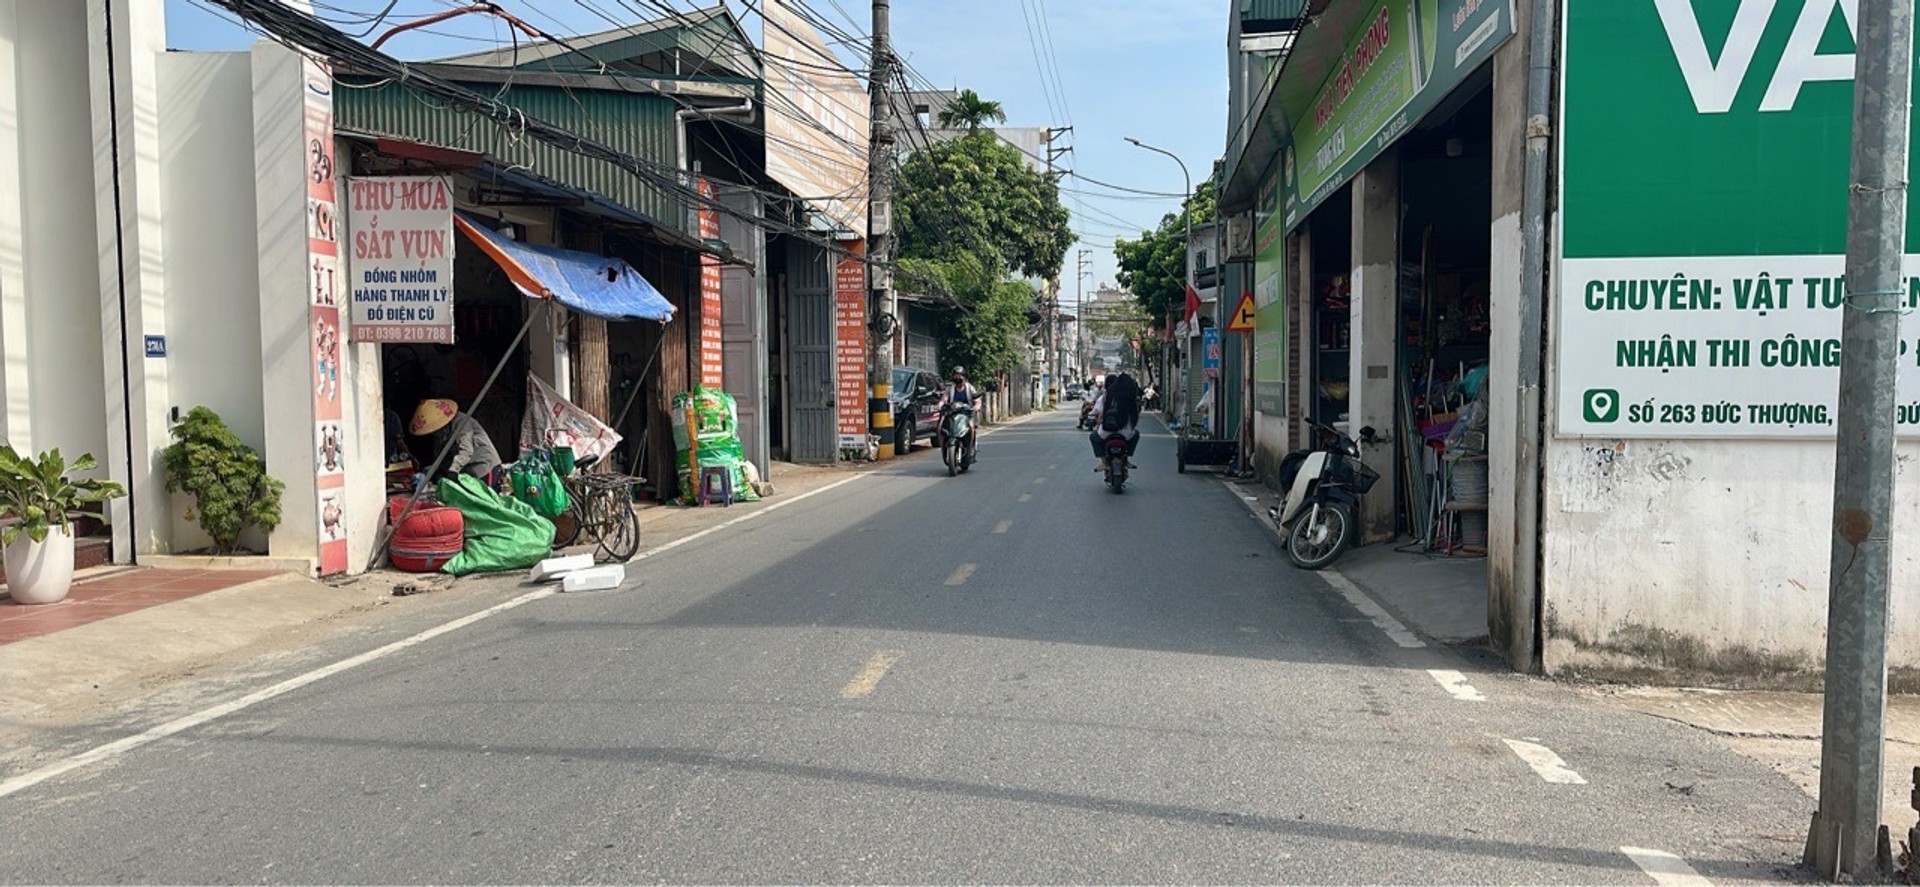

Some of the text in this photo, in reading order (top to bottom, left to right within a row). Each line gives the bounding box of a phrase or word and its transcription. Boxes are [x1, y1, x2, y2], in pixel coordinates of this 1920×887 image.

[1355, 5, 1389, 83] PHONG
[352, 181, 448, 211] THU MUA
[356, 215, 445, 267] SẮT VỤN
[400, 267, 437, 283] NHÔM
[354, 286, 447, 302] HÀNG THANH LÝ
[1584, 271, 1846, 317] CHUYÊN: VẬT TƯ
[386, 306, 415, 324] ĐIỆN
[418, 306, 435, 321] CŨ
[358, 327, 374, 340] ĐT:
[404, 327, 424, 340] 210
[426, 327, 447, 340] 788
[1616, 333, 1841, 373] NHẬN THI CÔNG
[1628, 398, 1833, 428] SỐ 263 ĐỨC THƯỢNG,
